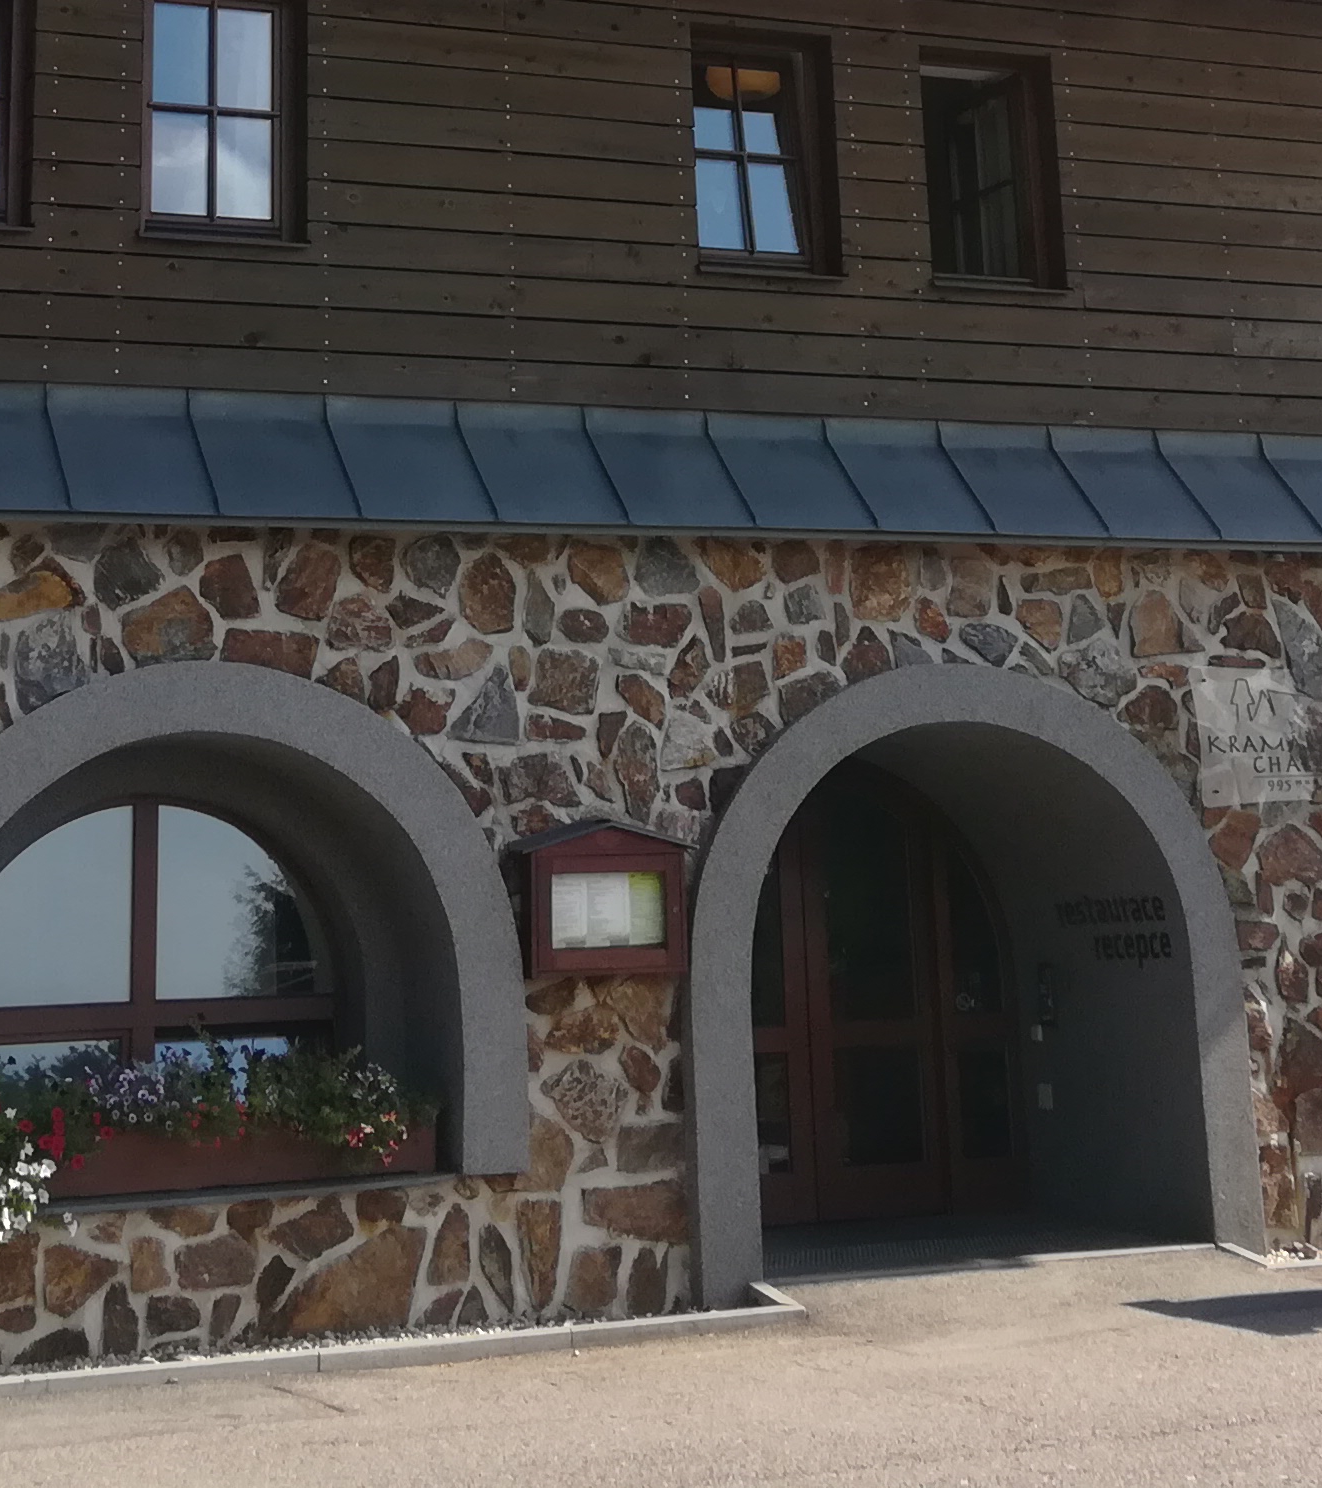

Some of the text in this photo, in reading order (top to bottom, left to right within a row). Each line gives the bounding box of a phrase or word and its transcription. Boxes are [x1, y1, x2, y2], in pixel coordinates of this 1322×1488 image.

[1267, 779, 1292, 792] 995
[1054, 895, 1167, 928] restaurace
[1093, 931, 1172, 969] recepce
